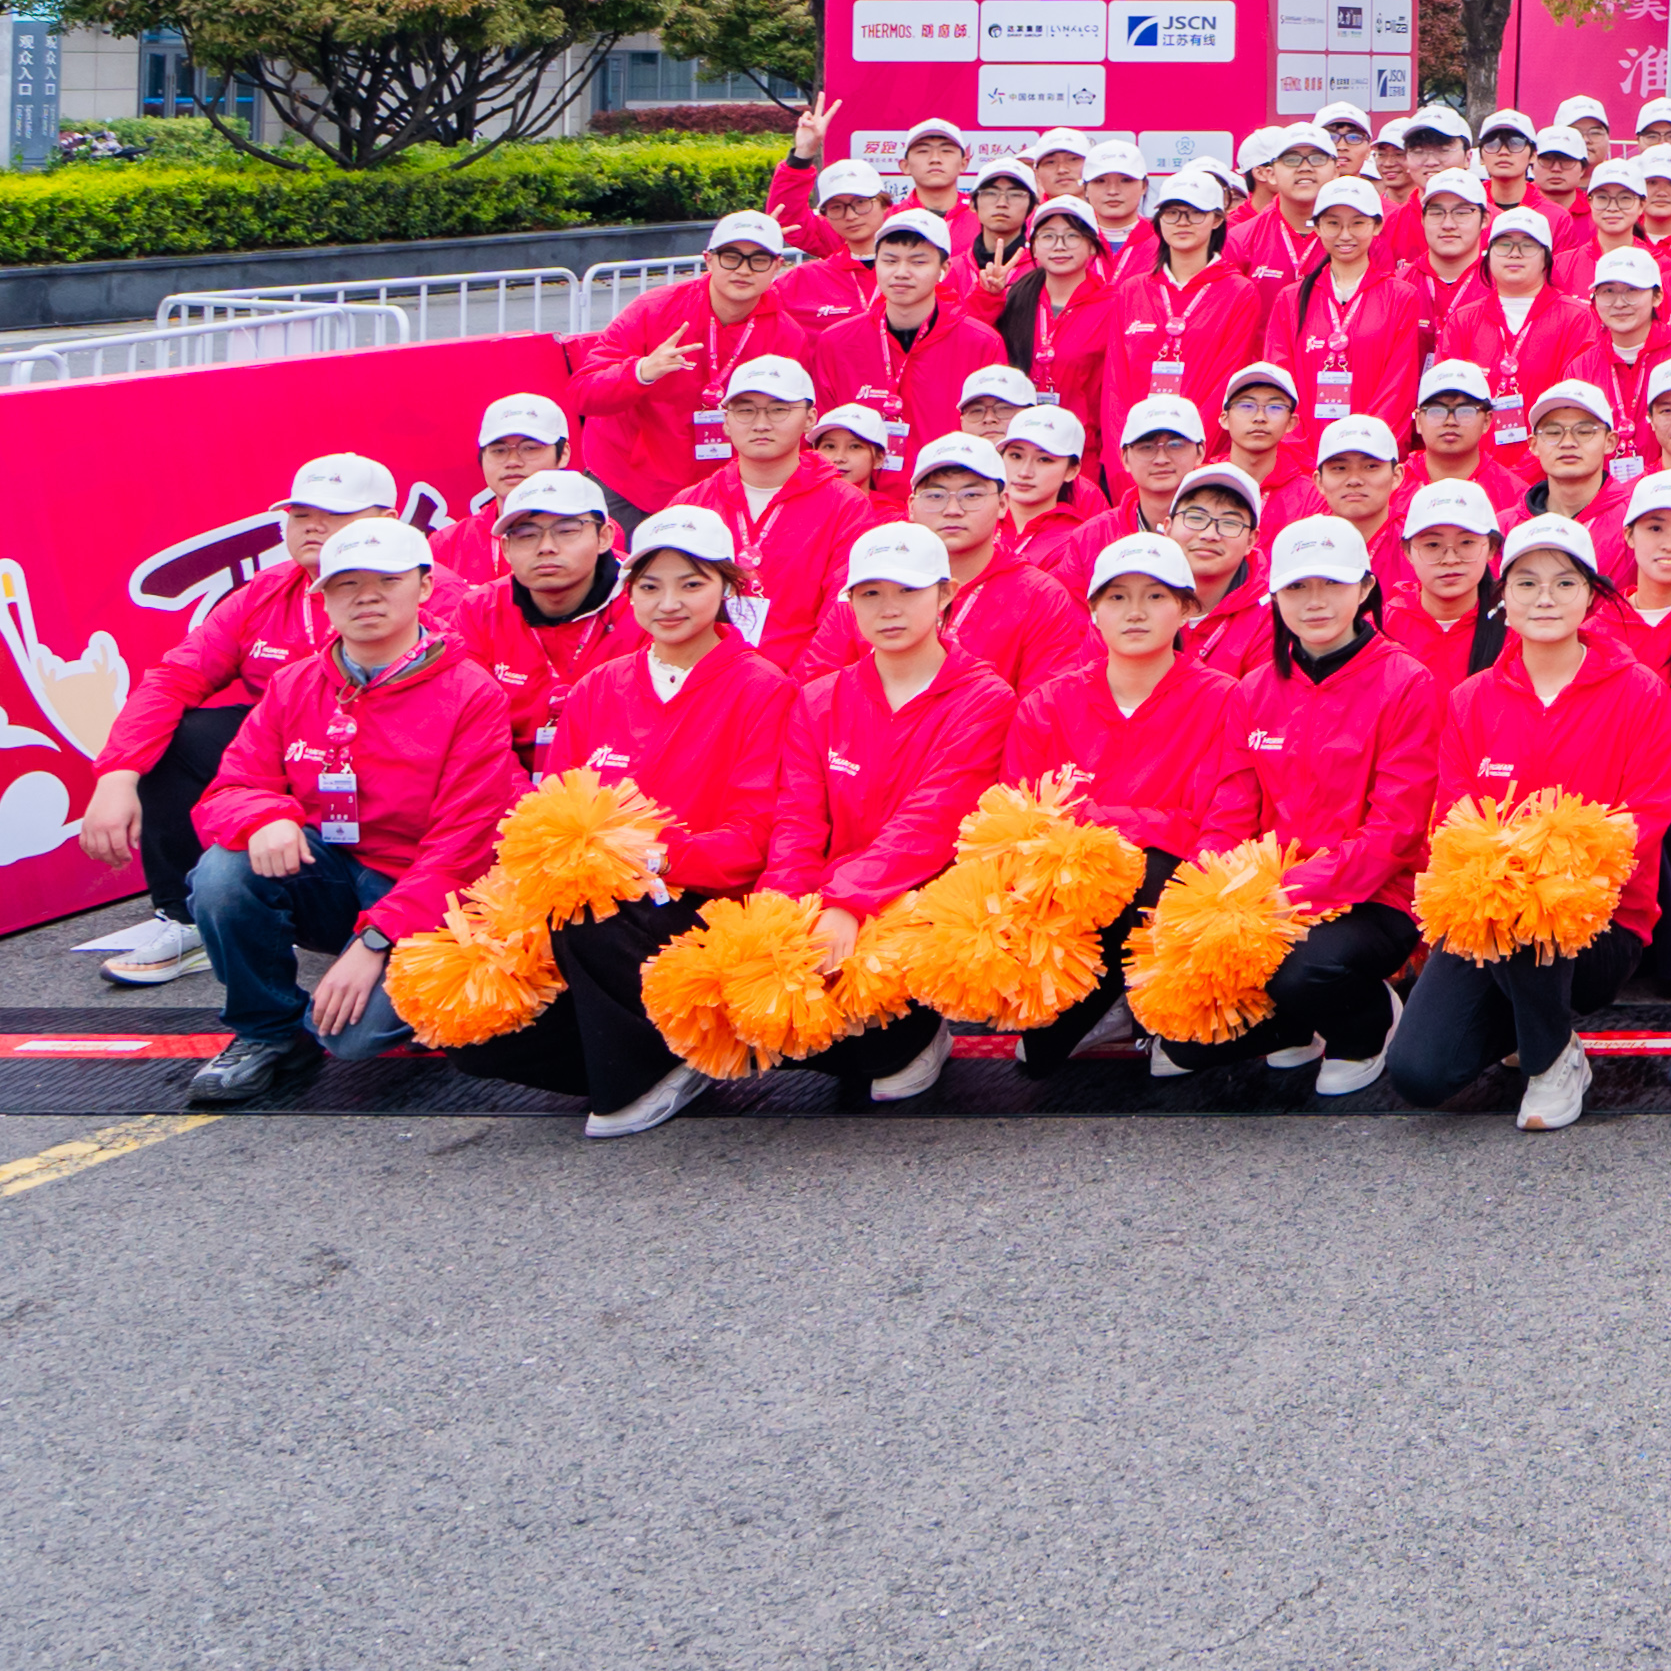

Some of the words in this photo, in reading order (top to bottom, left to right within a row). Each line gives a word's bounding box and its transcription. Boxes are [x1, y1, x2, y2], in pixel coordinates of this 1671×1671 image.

[1162, 33, 1216, 47] 江苏有线
[1163, 15, 1217, 30] JSCN
[17, 34, 35, 96] 观众入口
[44, 35, 58, 96] 观众入口
